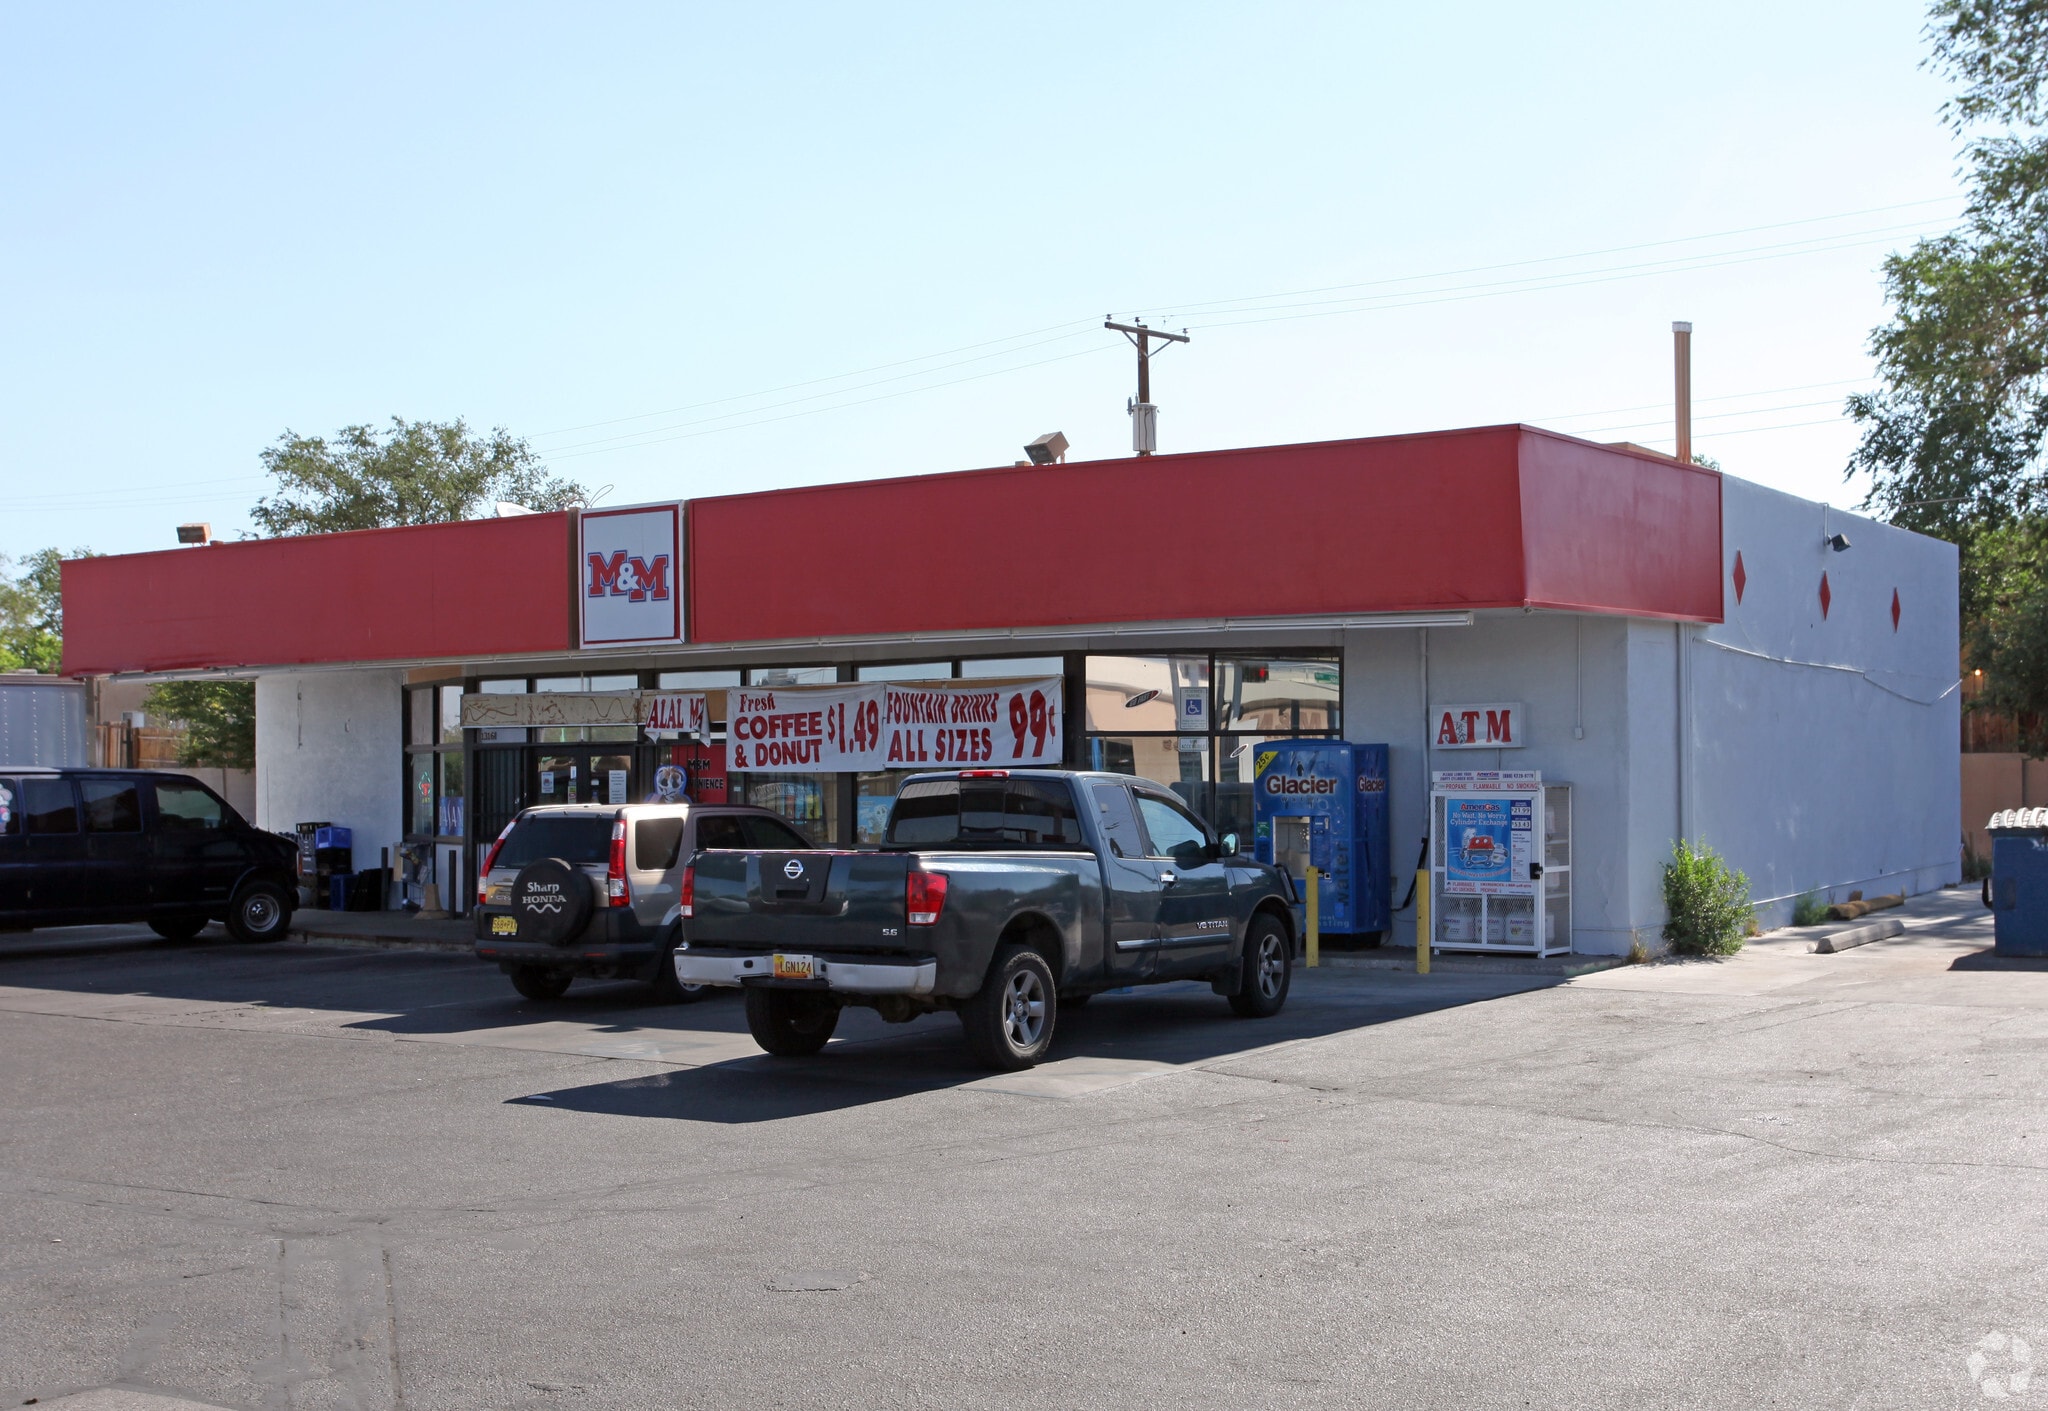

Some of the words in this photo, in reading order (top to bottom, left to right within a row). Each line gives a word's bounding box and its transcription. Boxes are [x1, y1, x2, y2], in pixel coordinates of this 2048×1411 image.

[588, 550, 669, 603] M&M
[739, 693, 776, 713] Fresh
[886, 692, 949, 724] FOUNTAIN
[951, 692, 1000, 723] DRINKS
[646, 698, 684, 729] ALAL
[733, 711, 822, 740] COFFEE
[827, 699, 879, 754] $1.49
[1437, 709, 1512, 745] ATM
[734, 743, 749, 768] &
[755, 738, 823, 767] DONUT
[887, 729, 928, 762] ALL
[935, 728, 993, 762] SIZES
[687, 759, 711, 770] M&M
[1266, 775, 1338, 795] Glacier
[1358, 776, 1386, 793] Glacier
[1460, 803, 1500, 811] AmeriGas
[1487, 812, 1507, 820] Worry
[1479, 819, 1508, 827] Exchange
[527, 882, 560, 894] Sharp
[522, 895, 567, 904] HONDA
[882, 928, 898, 936] 5.6
[1207, 920, 1228, 929] TITAN
[780, 961, 811, 974] LGN124
